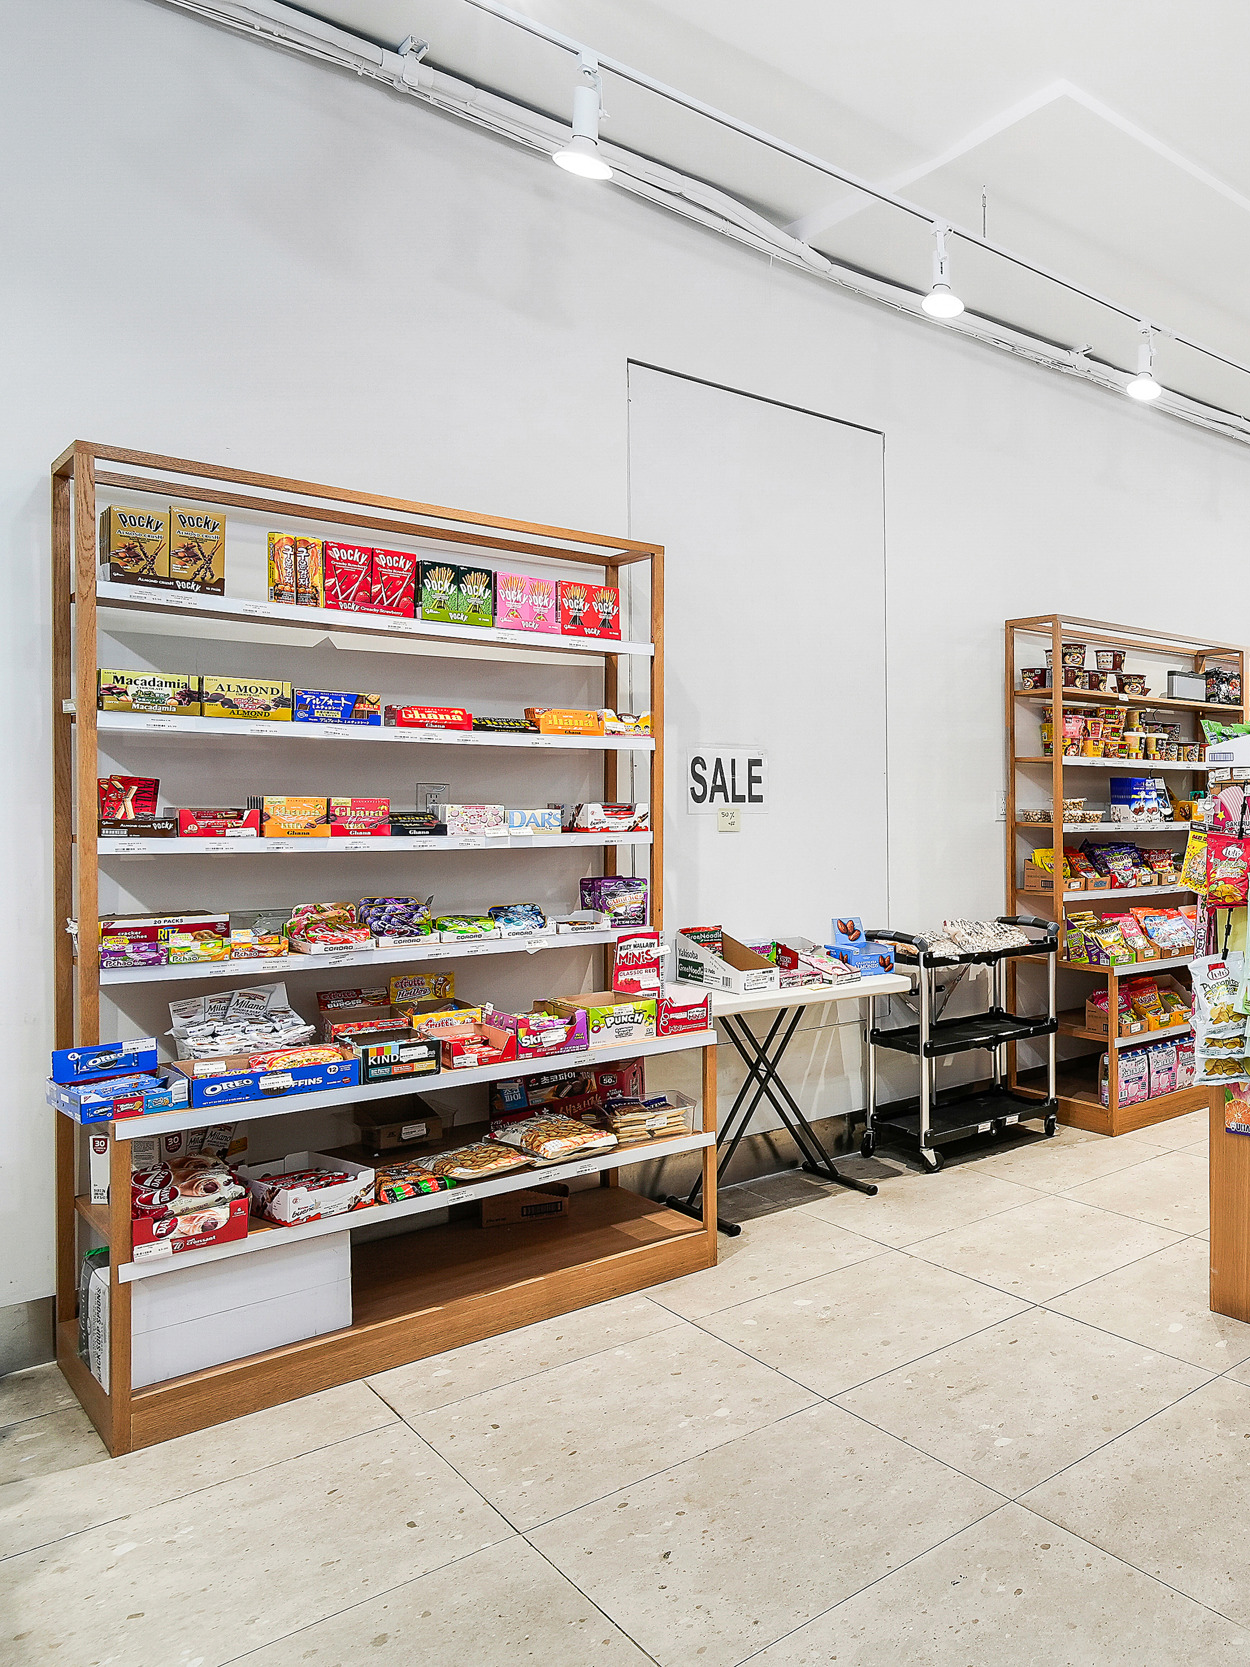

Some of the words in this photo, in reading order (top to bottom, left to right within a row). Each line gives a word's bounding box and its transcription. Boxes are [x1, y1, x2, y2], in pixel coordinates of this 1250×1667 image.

[118, 513, 164, 532] Pocky
[177, 514, 220, 532] Pocky
[332, 547, 369, 565] Pocky
[378, 555, 413, 570] Pocky
[176, 580, 201, 592] Pocky
[424, 578, 456, 594] Pocky
[459, 583, 491, 599] Pocky
[338, 601, 360, 612] Pocky
[113, 675, 188, 689] Macadamia
[215, 683, 281, 696] ALMOND
[131, 702, 177, 712] Macadamia
[229, 709, 271, 718] ALMOND
[402, 709, 463, 722] Ghana
[690, 756, 763, 804] SALE
[269, 805, 321, 817] Ghana
[334, 806, 384, 817] Ghana
[152, 821, 174, 831] Pocky
[1225, 820, 1250, 828] SAKRU
[206, 1004, 229, 1014] Mila
[231, 998, 267, 1011] Milano
[605, 1013, 644, 1028] PUNCH
[88, 1052, 125, 1067] OREO
[368, 1055, 399, 1066] KIND
[204, 1078, 254, 1097] OREO
[167, 1136, 180, 1146] 30
[206, 1130, 232, 1144] Milano
[93, 1139, 105, 1149] 30
